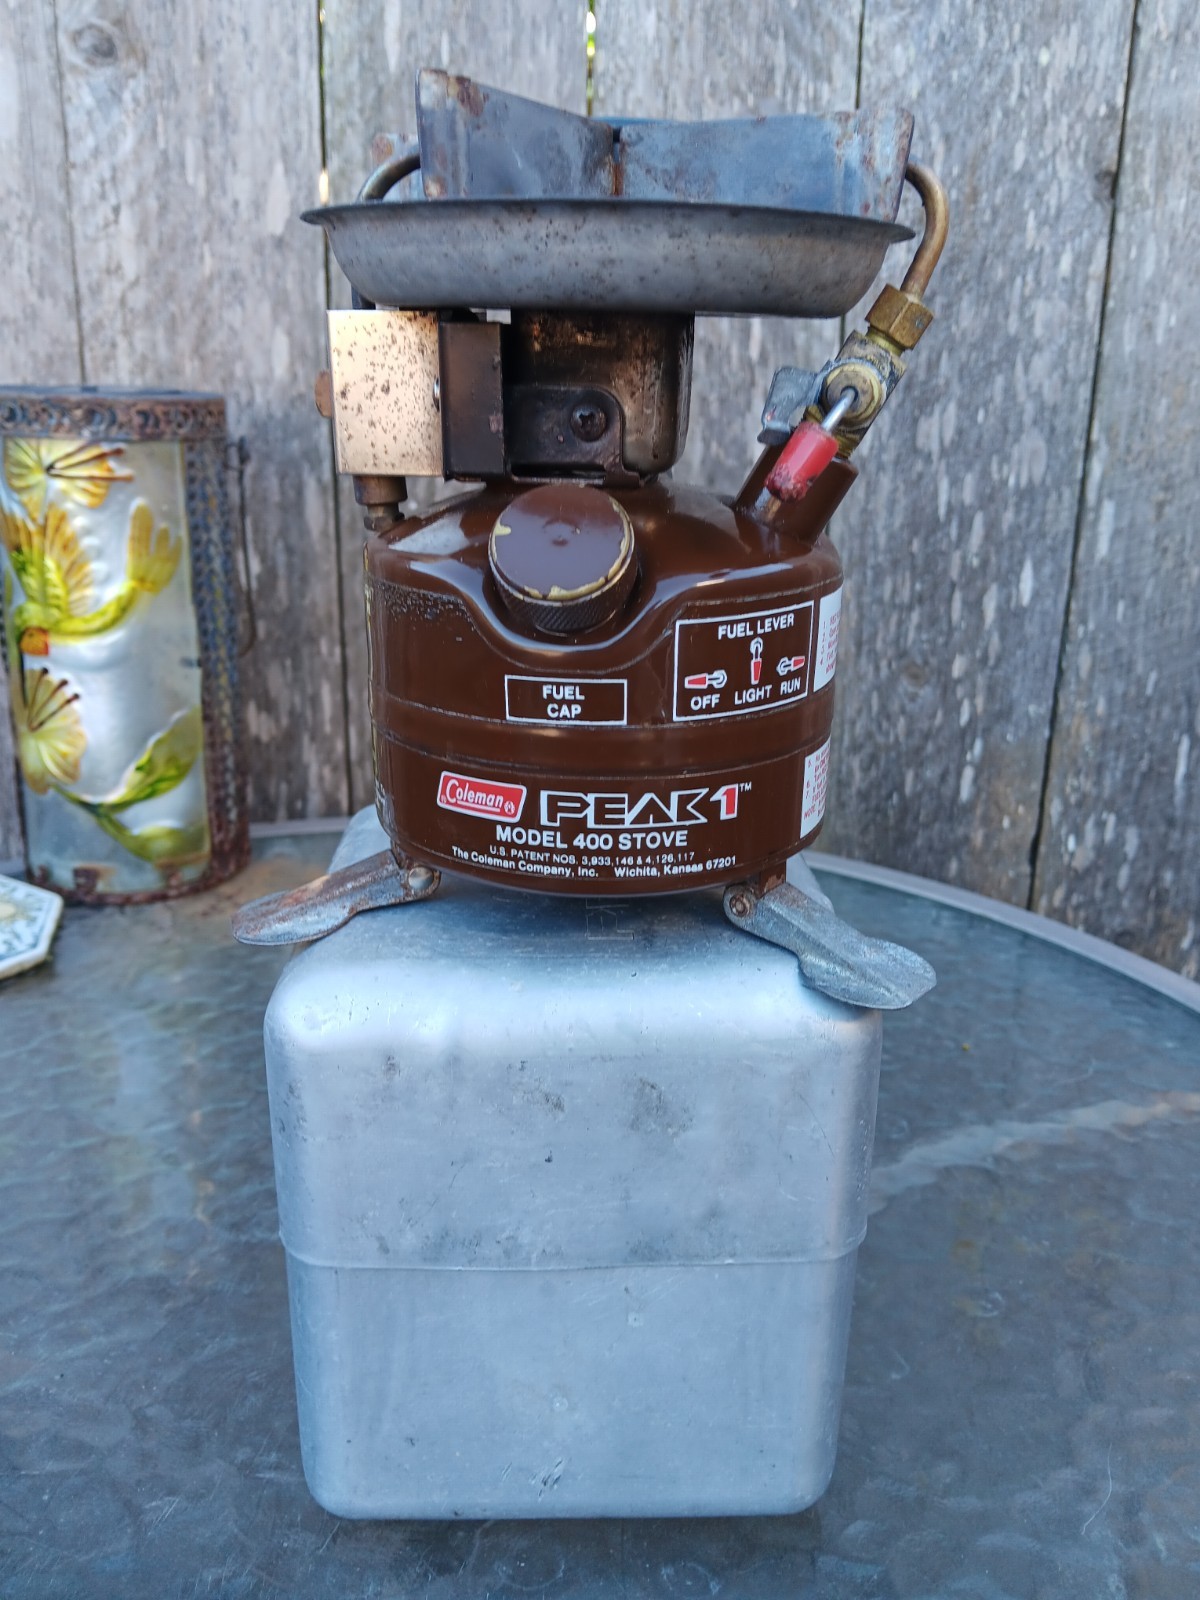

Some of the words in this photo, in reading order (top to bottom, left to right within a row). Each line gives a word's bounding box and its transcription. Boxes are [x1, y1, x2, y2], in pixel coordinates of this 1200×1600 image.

[718, 622, 753, 640] FUEL
[757, 613, 795, 634] LEVER
[542, 684, 585, 700] FUEL
[690, 694, 721, 711] OFF
[734, 685, 773, 705] LIGHT
[780, 677, 801, 695] RUN
[547, 703, 582, 718] CAP
[446, 779, 503, 808] Coleman
[540, 788, 709, 829] PEAK
[496, 825, 568, 849] MODEL
[573, 833, 613, 851] 400
[618, 830, 688, 850] STOVE
[451, 846, 469, 860] The
[470, 851, 516, 869] Coleman
[518, 860, 575, 878] Company,
[578, 866, 599, 878] Inc.
[614, 866, 661, 878] Wichita,
[663, 864, 704, 875] Kansas
[705, 855, 736, 871] 67201
[489, 845, 508, 857] U.S.
[511, 848, 550, 862] PATENT
[552, 853, 578, 865] NOS.
